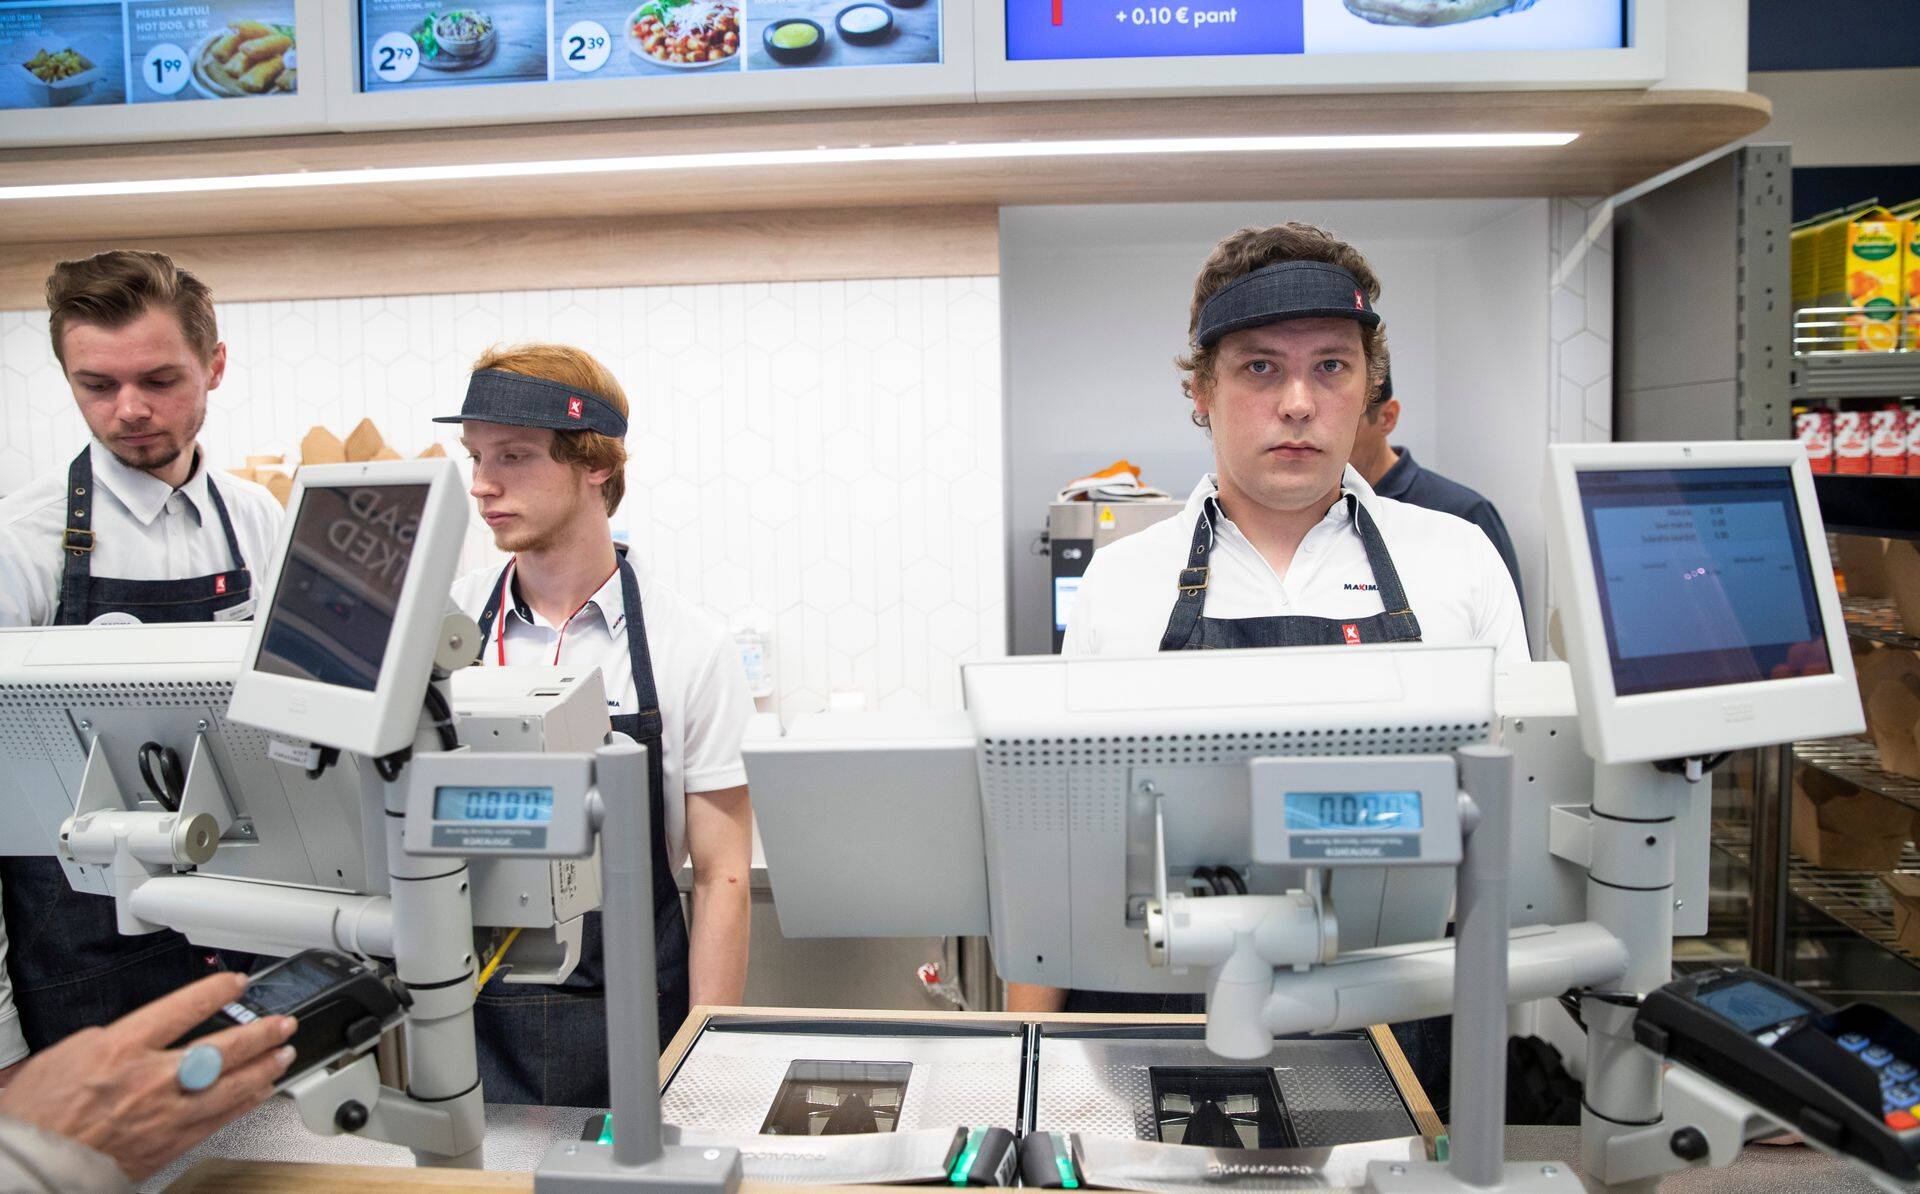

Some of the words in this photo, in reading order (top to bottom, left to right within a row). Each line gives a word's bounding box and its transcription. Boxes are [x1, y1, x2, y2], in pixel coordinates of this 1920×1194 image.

[1131, 7, 1172, 25] 0.10
[1175, 6, 1189, 24] €
[1193, 8, 1237, 28] pant
[136, 21, 157, 33] HOT
